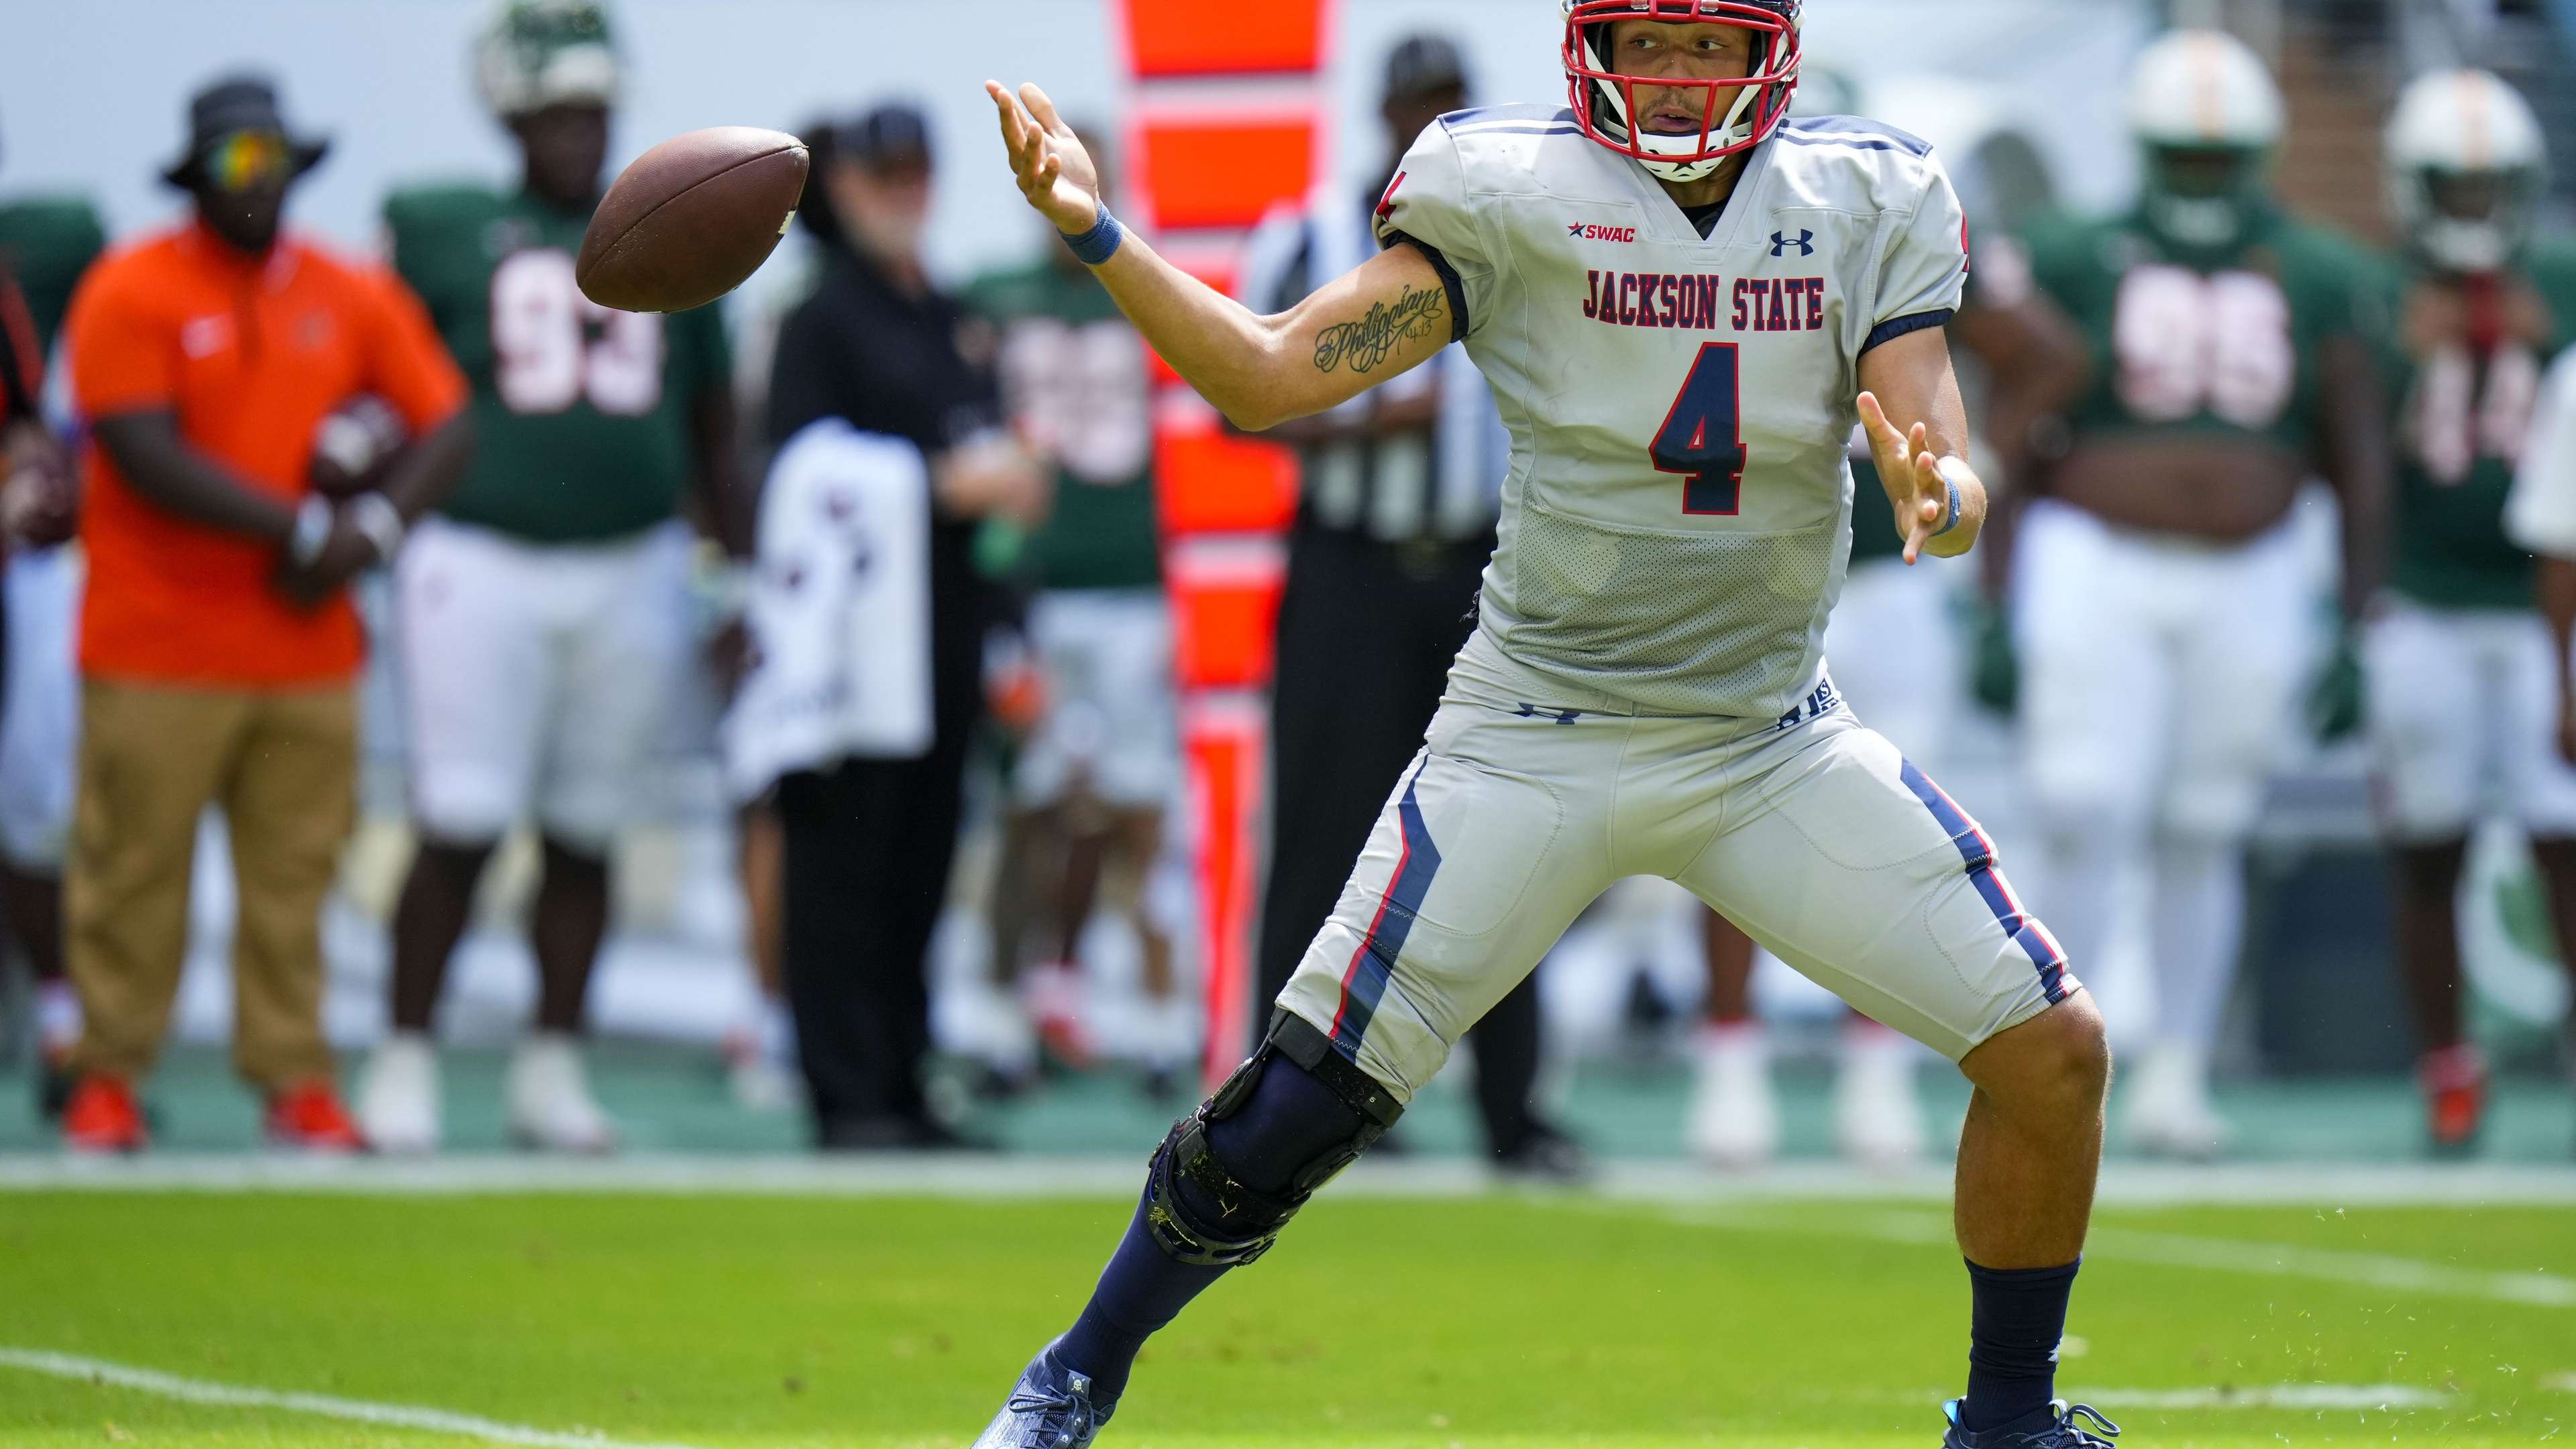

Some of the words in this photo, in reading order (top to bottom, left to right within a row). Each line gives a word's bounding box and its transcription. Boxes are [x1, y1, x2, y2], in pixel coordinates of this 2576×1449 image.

[1585, 224, 1635, 244] SWAC
[1582, 270, 1719, 329] JACKSON
[1731, 276, 1825, 331] STATE
[1648, 341, 1748, 516] 4
